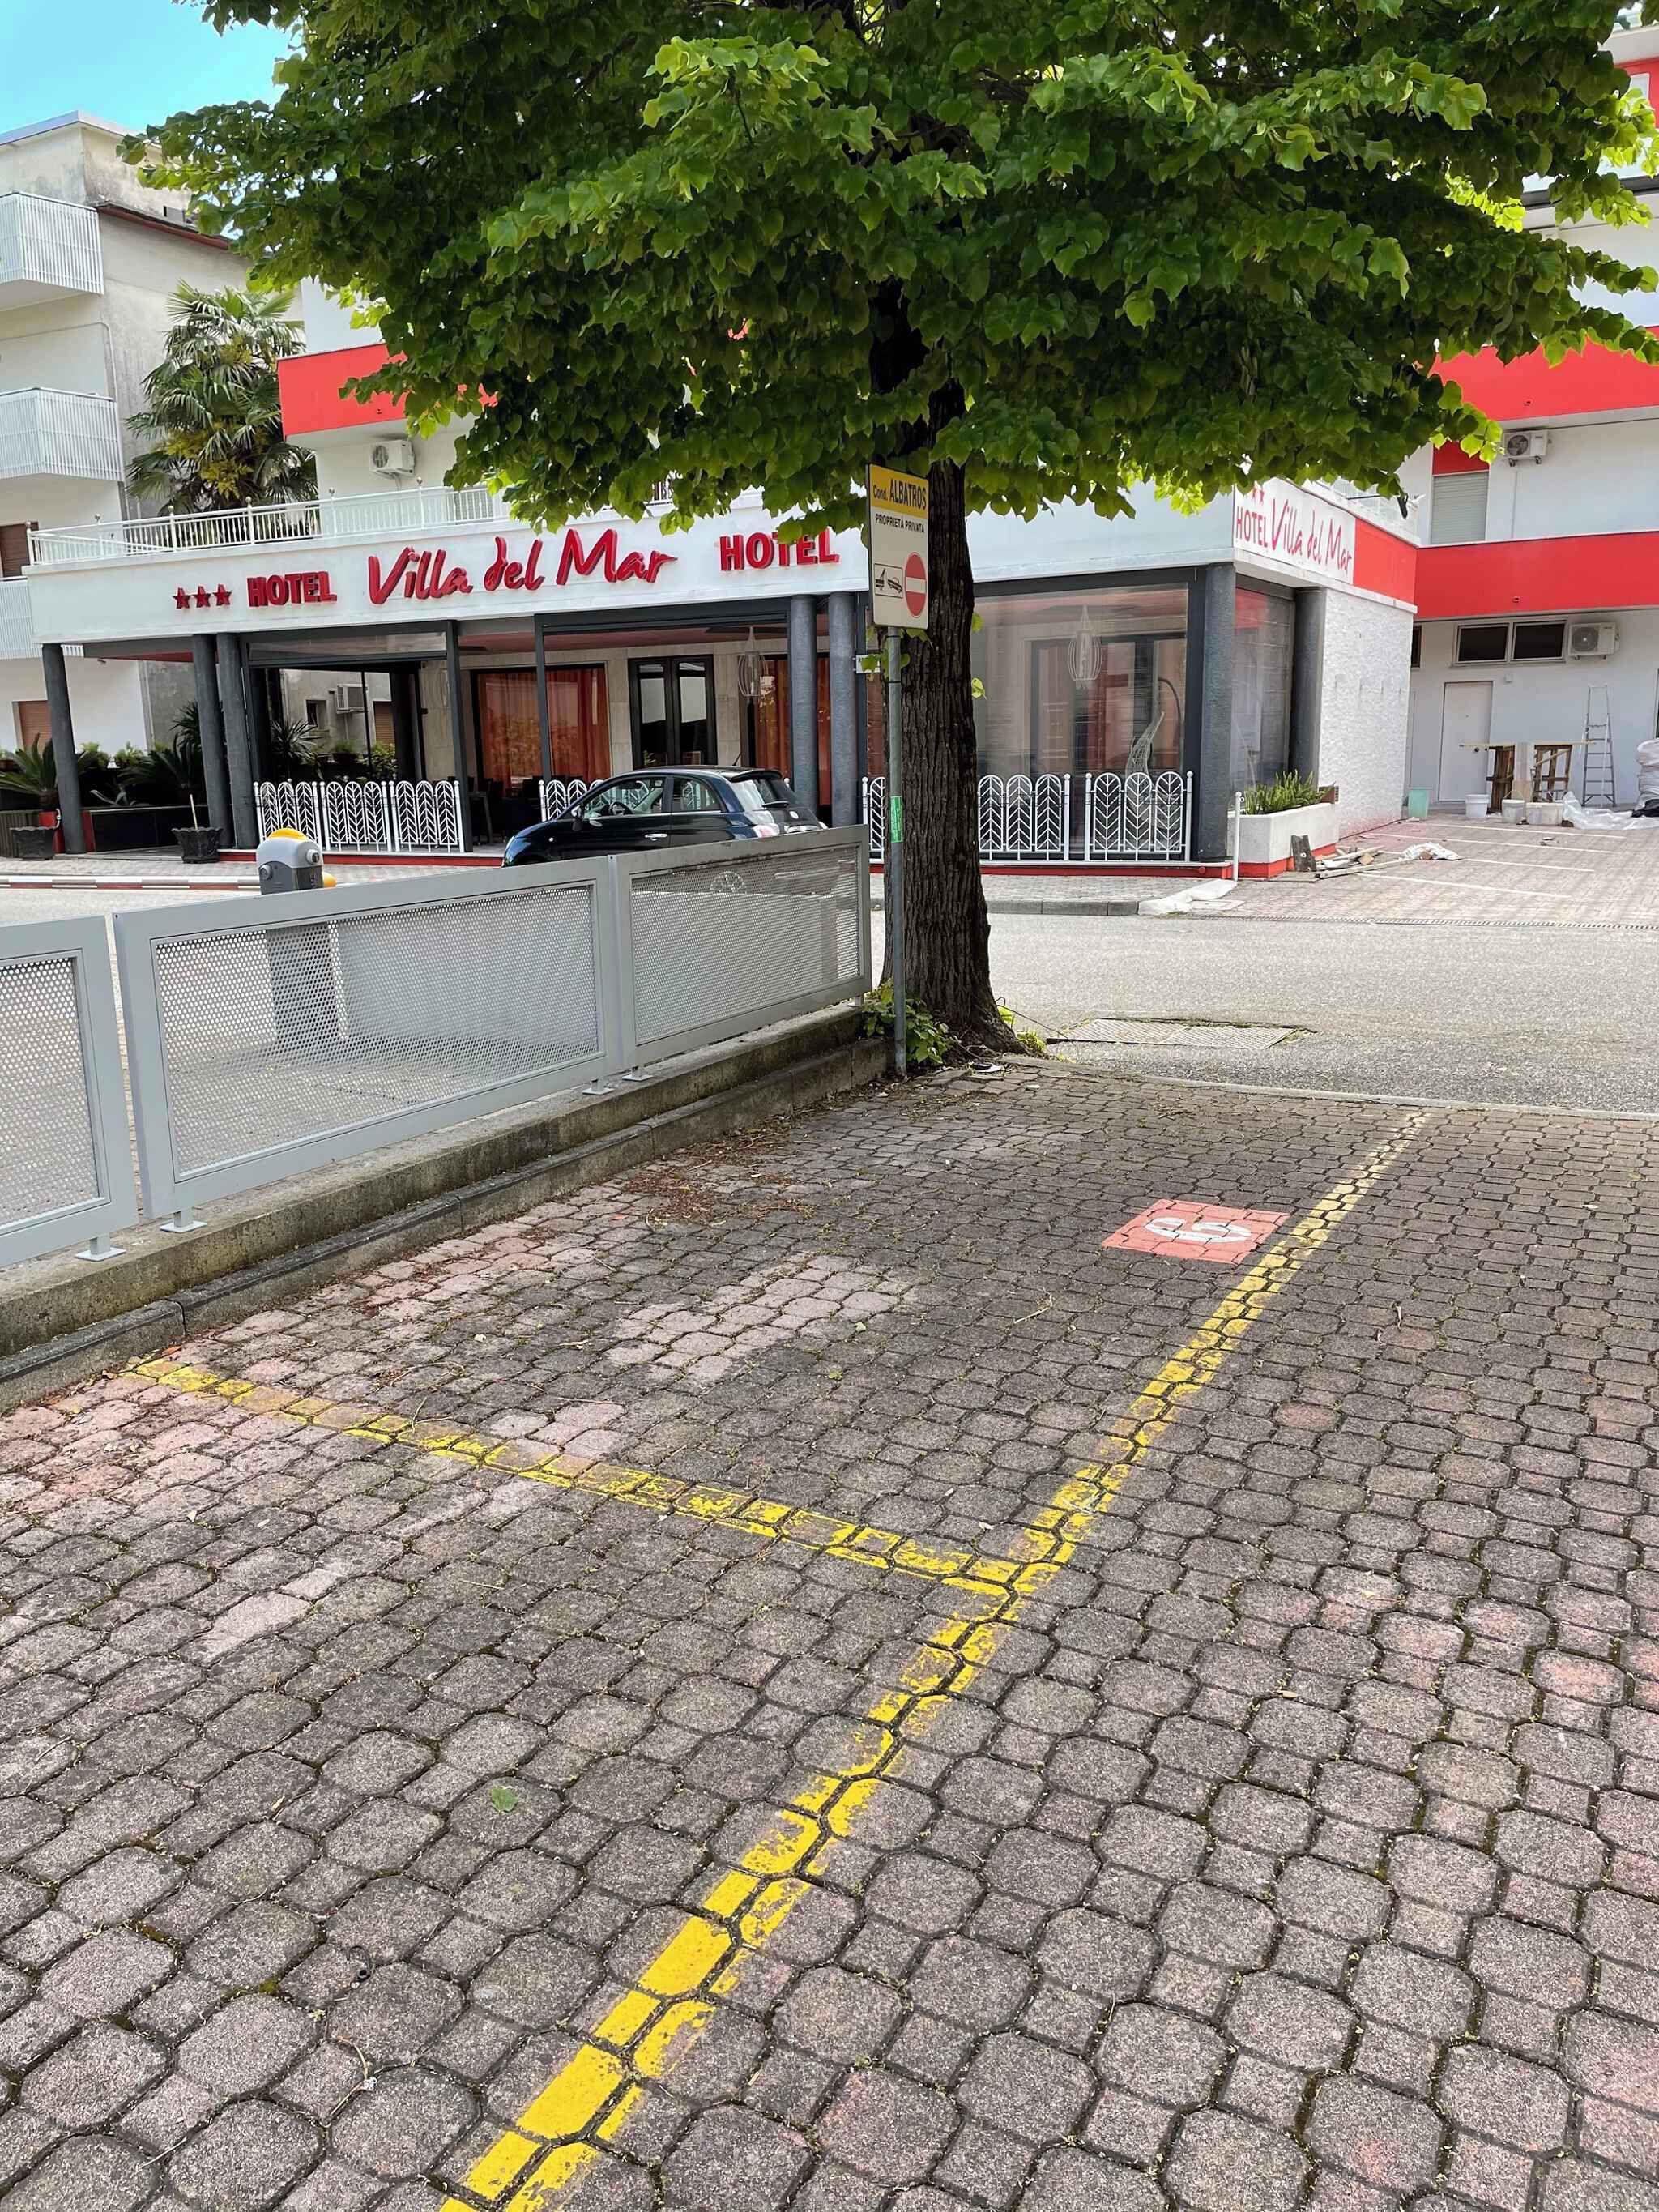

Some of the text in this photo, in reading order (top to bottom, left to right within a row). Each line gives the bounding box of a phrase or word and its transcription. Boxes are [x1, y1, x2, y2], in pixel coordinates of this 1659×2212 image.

[872, 478, 927, 510] Cond. ALBATROS
[905, 520, 925, 534] PRIVATA
[1235, 498, 1352, 576] HOTEL Villa del Mar
[247, 527, 679, 608] HOTEL Villa del Mar
